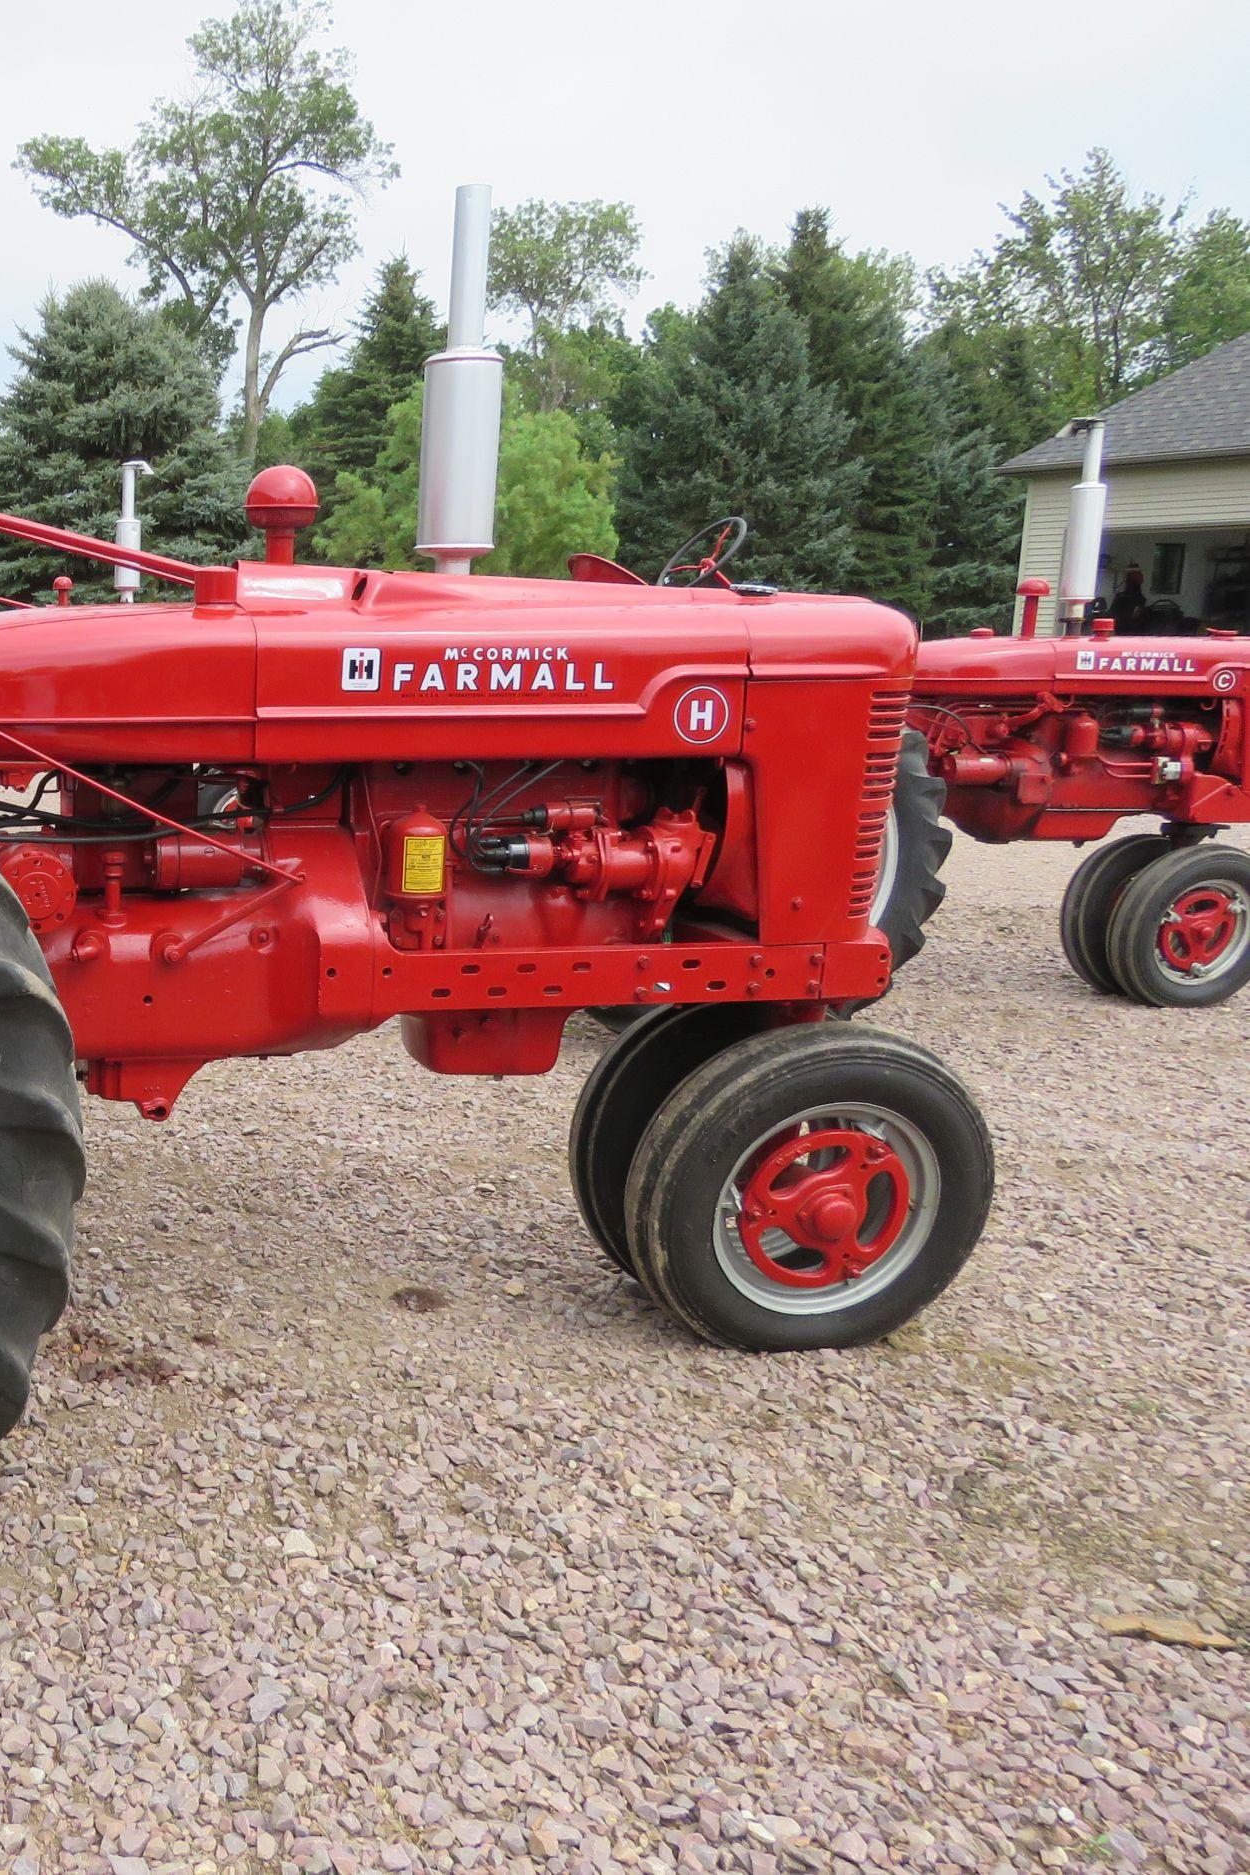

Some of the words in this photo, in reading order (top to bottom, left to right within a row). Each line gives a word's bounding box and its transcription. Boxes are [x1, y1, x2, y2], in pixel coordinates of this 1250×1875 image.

[1098, 658, 1195, 672] FARMALL
[392, 662, 615, 692] FARMALL
[1218, 674, 1231, 689] C
[689, 699, 715, 732] H
